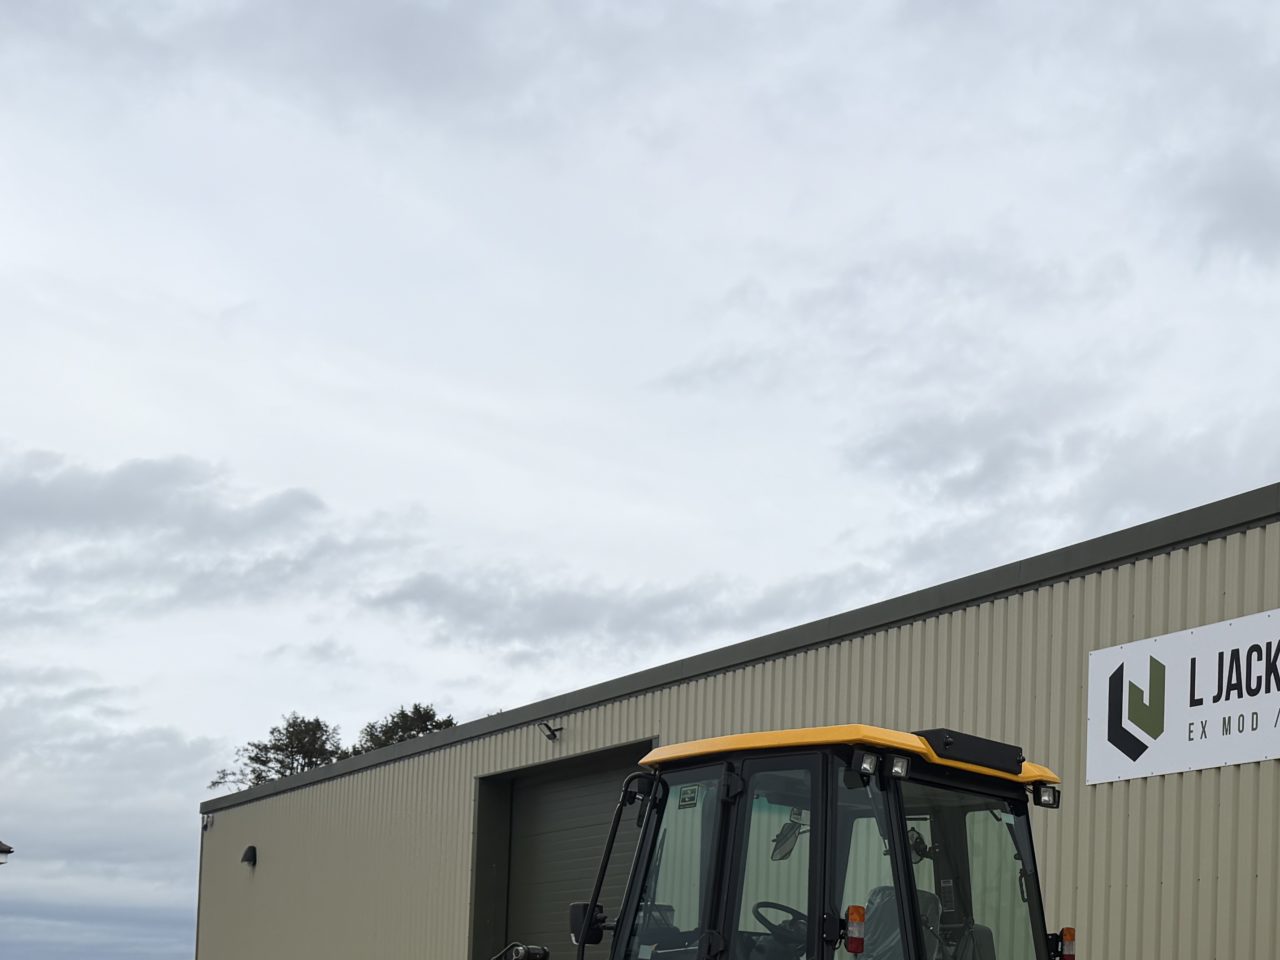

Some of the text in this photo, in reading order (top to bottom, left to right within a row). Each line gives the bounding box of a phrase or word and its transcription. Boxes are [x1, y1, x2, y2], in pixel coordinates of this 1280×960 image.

[1190, 657, 1203, 707] L
[1188, 720, 1208, 741] EX
[1222, 711, 1259, 736] MOD
